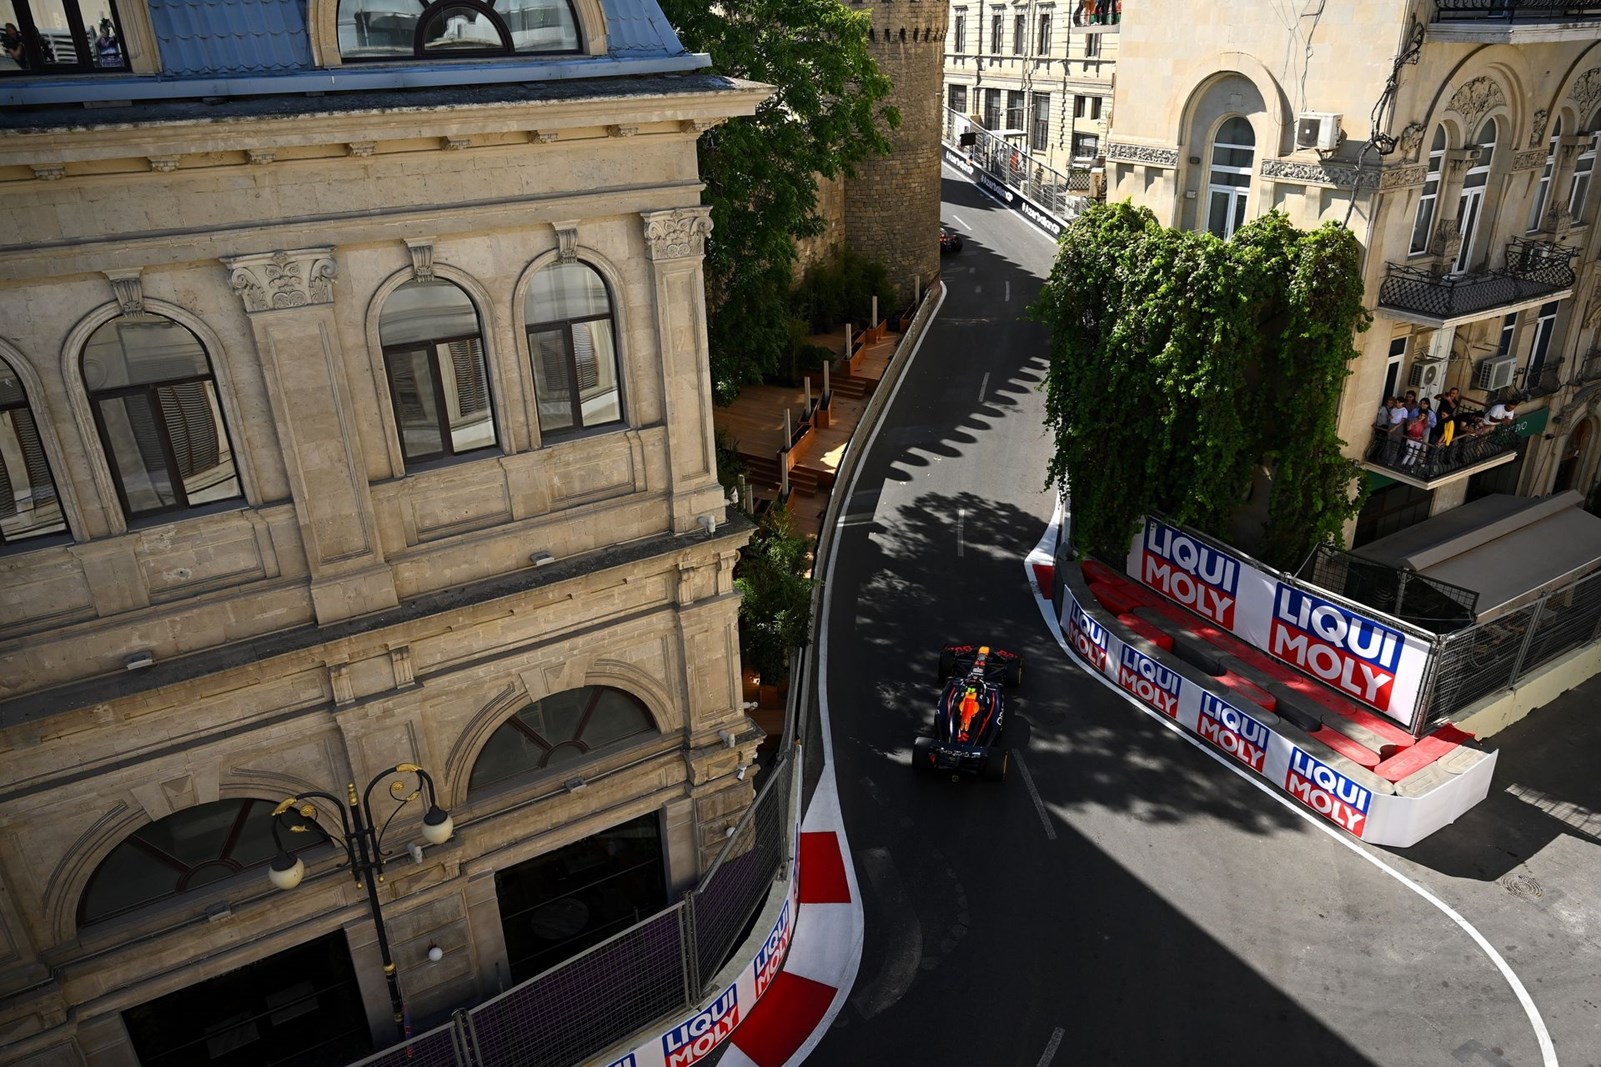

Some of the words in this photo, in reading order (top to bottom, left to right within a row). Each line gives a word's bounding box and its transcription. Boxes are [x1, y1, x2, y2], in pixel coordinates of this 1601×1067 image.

[1148, 521, 1235, 593] LIQUI
[1146, 554, 1234, 623] MOLY
[1070, 622, 1106, 667] MOLY
[1072, 601, 1108, 650] LIQUI
[1279, 587, 1397, 668] LIQUI
[1121, 667, 1177, 714] MOLY
[1123, 647, 1179, 695] LIQUI
[1274, 623, 1393, 702] MOLY
[1200, 716, 1264, 768] MOLY
[1203, 695, 1268, 748] LIQUI
[1288, 773, 1365, 831] MOLY
[1292, 751, 1368, 810] LIQUI
[756, 904, 789, 976] LIQUI
[757, 924, 790, 996] MOLY
[666, 987, 734, 1053] LIQUI
[669, 1005, 737, 1067] MOLY
